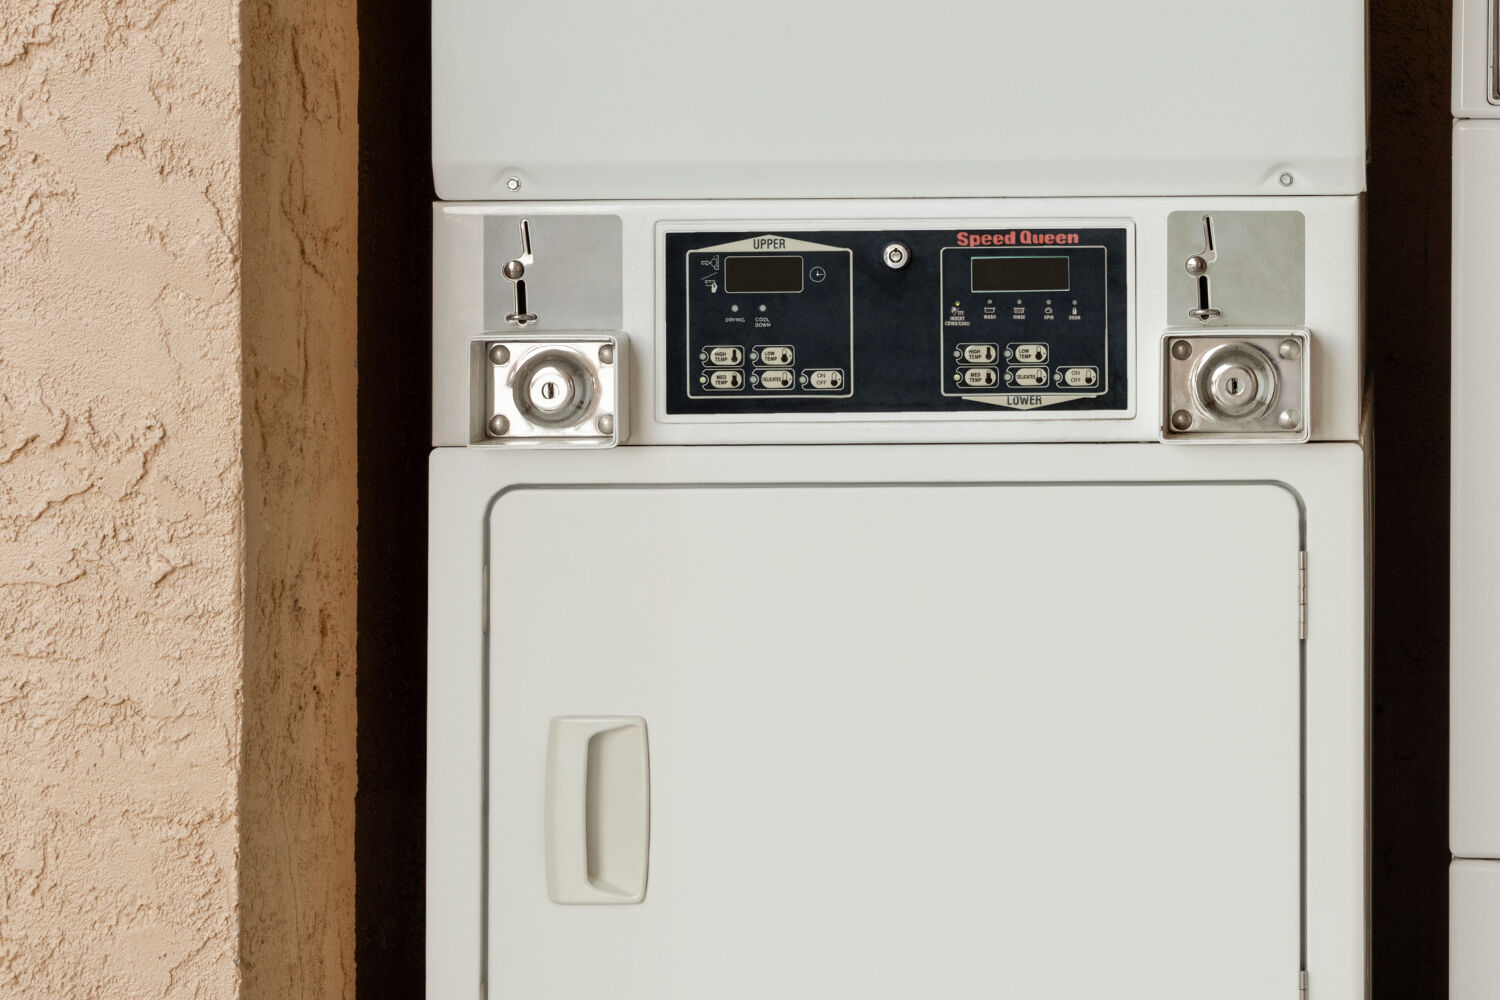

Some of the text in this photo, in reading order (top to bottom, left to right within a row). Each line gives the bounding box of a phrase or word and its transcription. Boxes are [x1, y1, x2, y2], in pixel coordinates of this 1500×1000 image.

[753, 238, 786, 250] UPPER
[956, 230, 1079, 247] Speed Queen
[1007, 395, 1042, 406] LOWER
